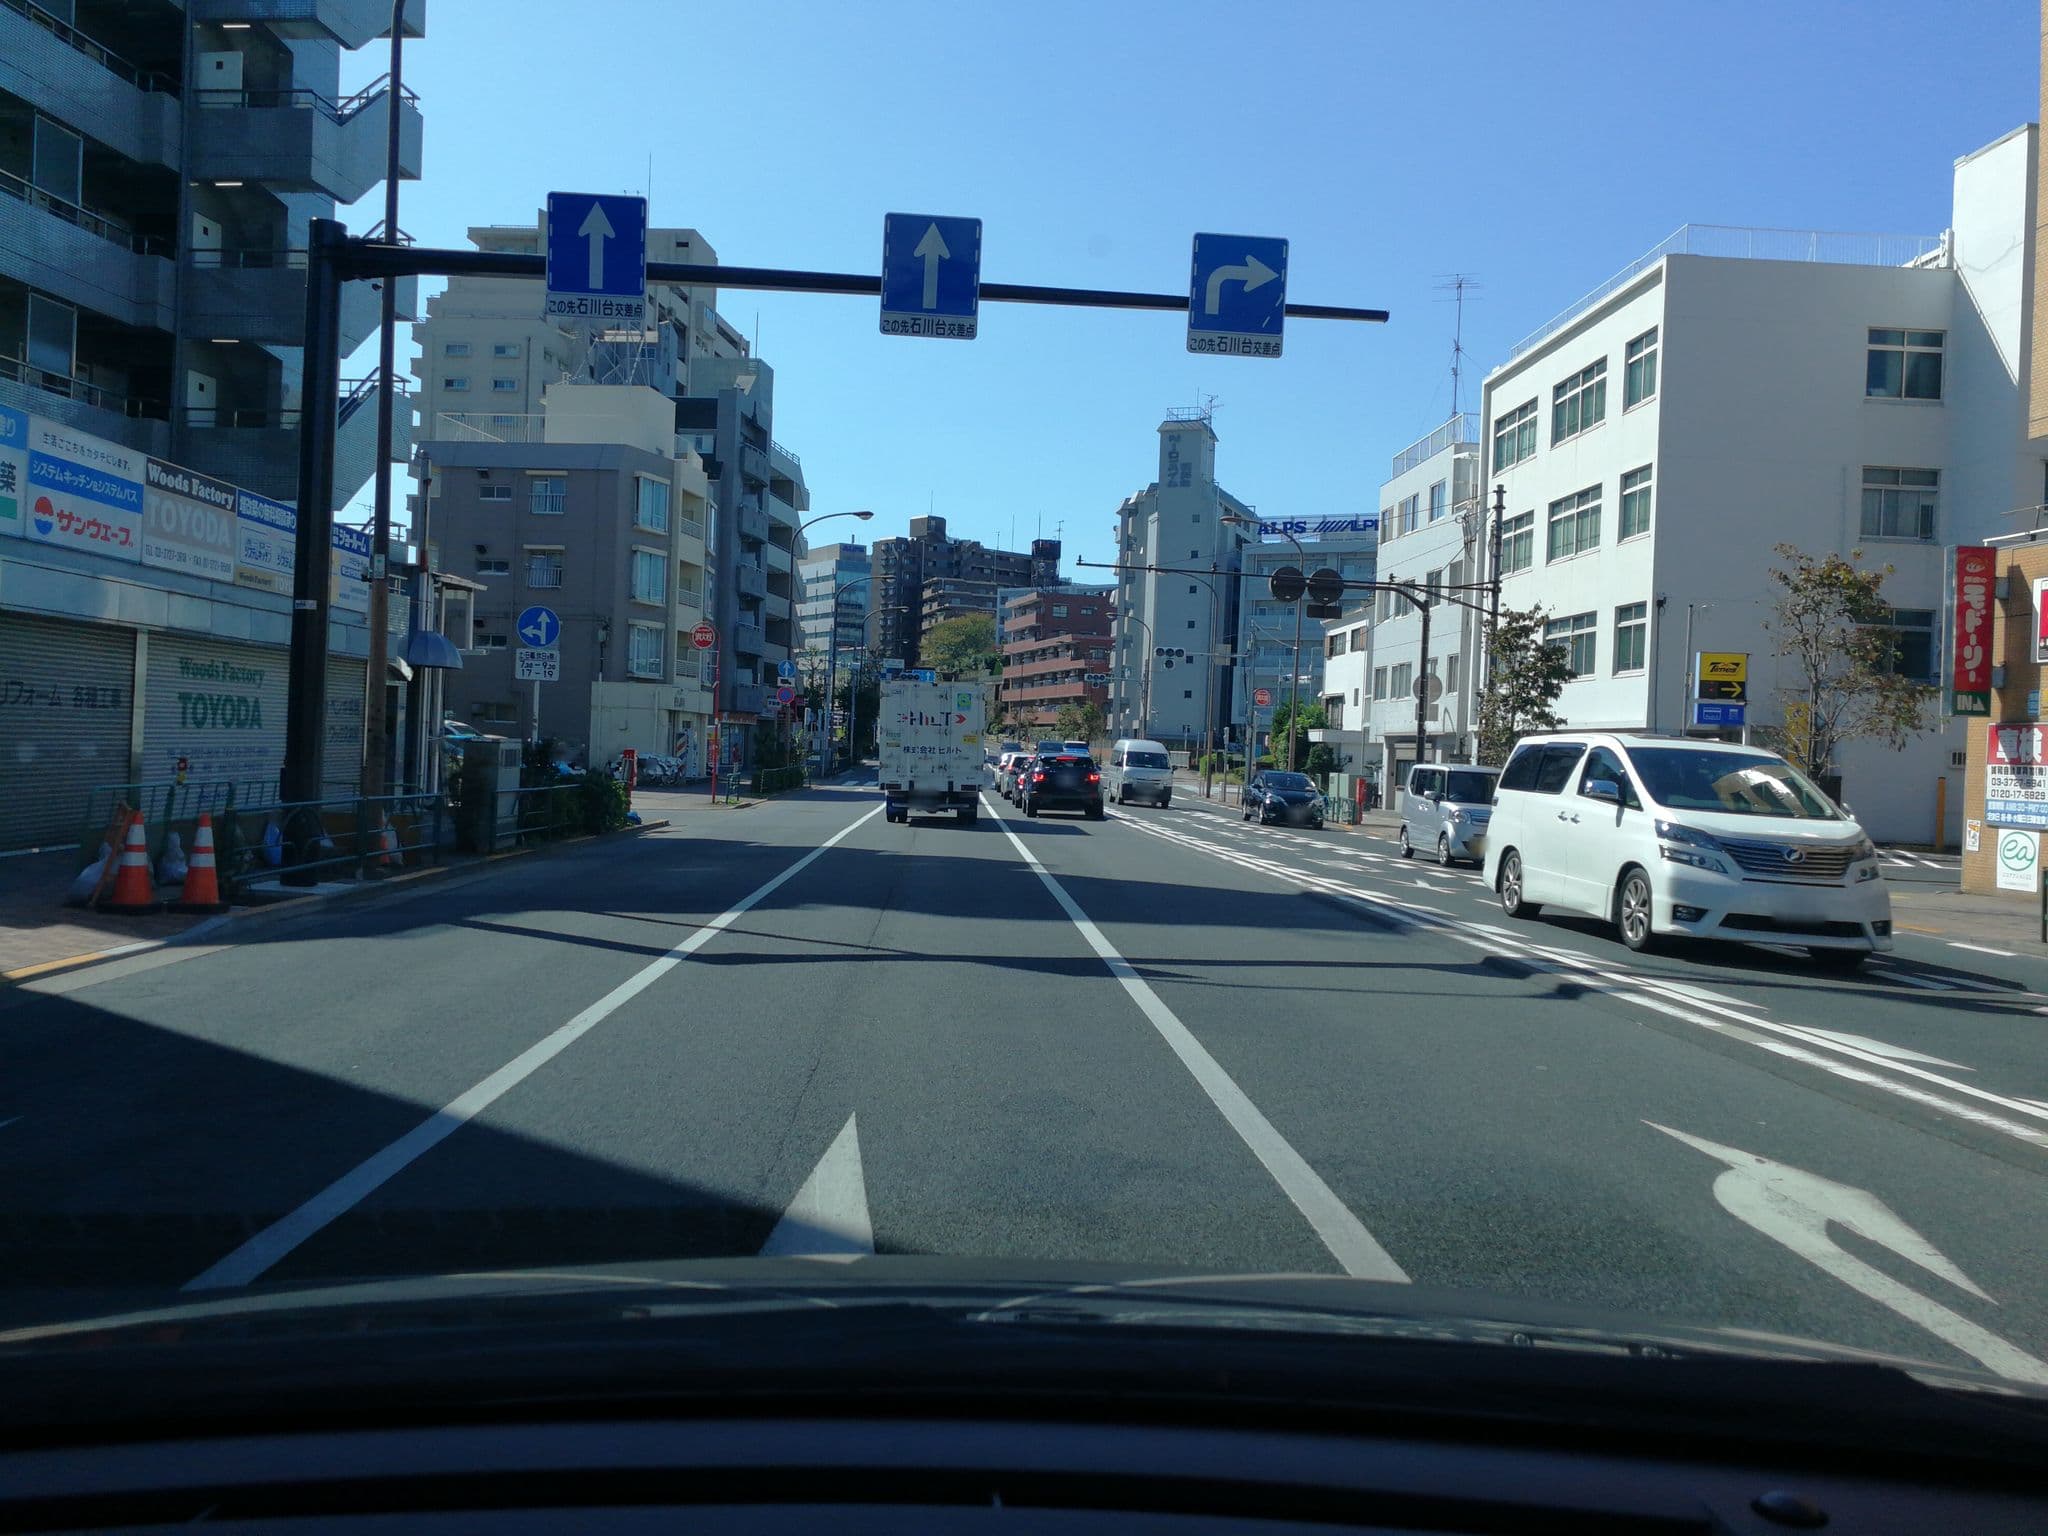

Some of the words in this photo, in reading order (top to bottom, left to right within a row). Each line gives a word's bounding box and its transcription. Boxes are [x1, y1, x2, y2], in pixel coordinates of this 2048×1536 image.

[549, 298, 643, 318] この先石川台交差点
[882, 317, 975, 337] この先石川台交差点
[1190, 336, 1280, 356] この先石川台交差点
[148, 462, 190, 493] Woods
[192, 479, 235, 510] Factory
[147, 493, 231, 547] TOYODA
[1258, 521, 1307, 535] ALPS
[179, 657, 219, 680] Woods
[221, 661, 266, 688] Factory
[178, 692, 263, 729] TOYODA
[1996, 728, 2043, 763] 車検
